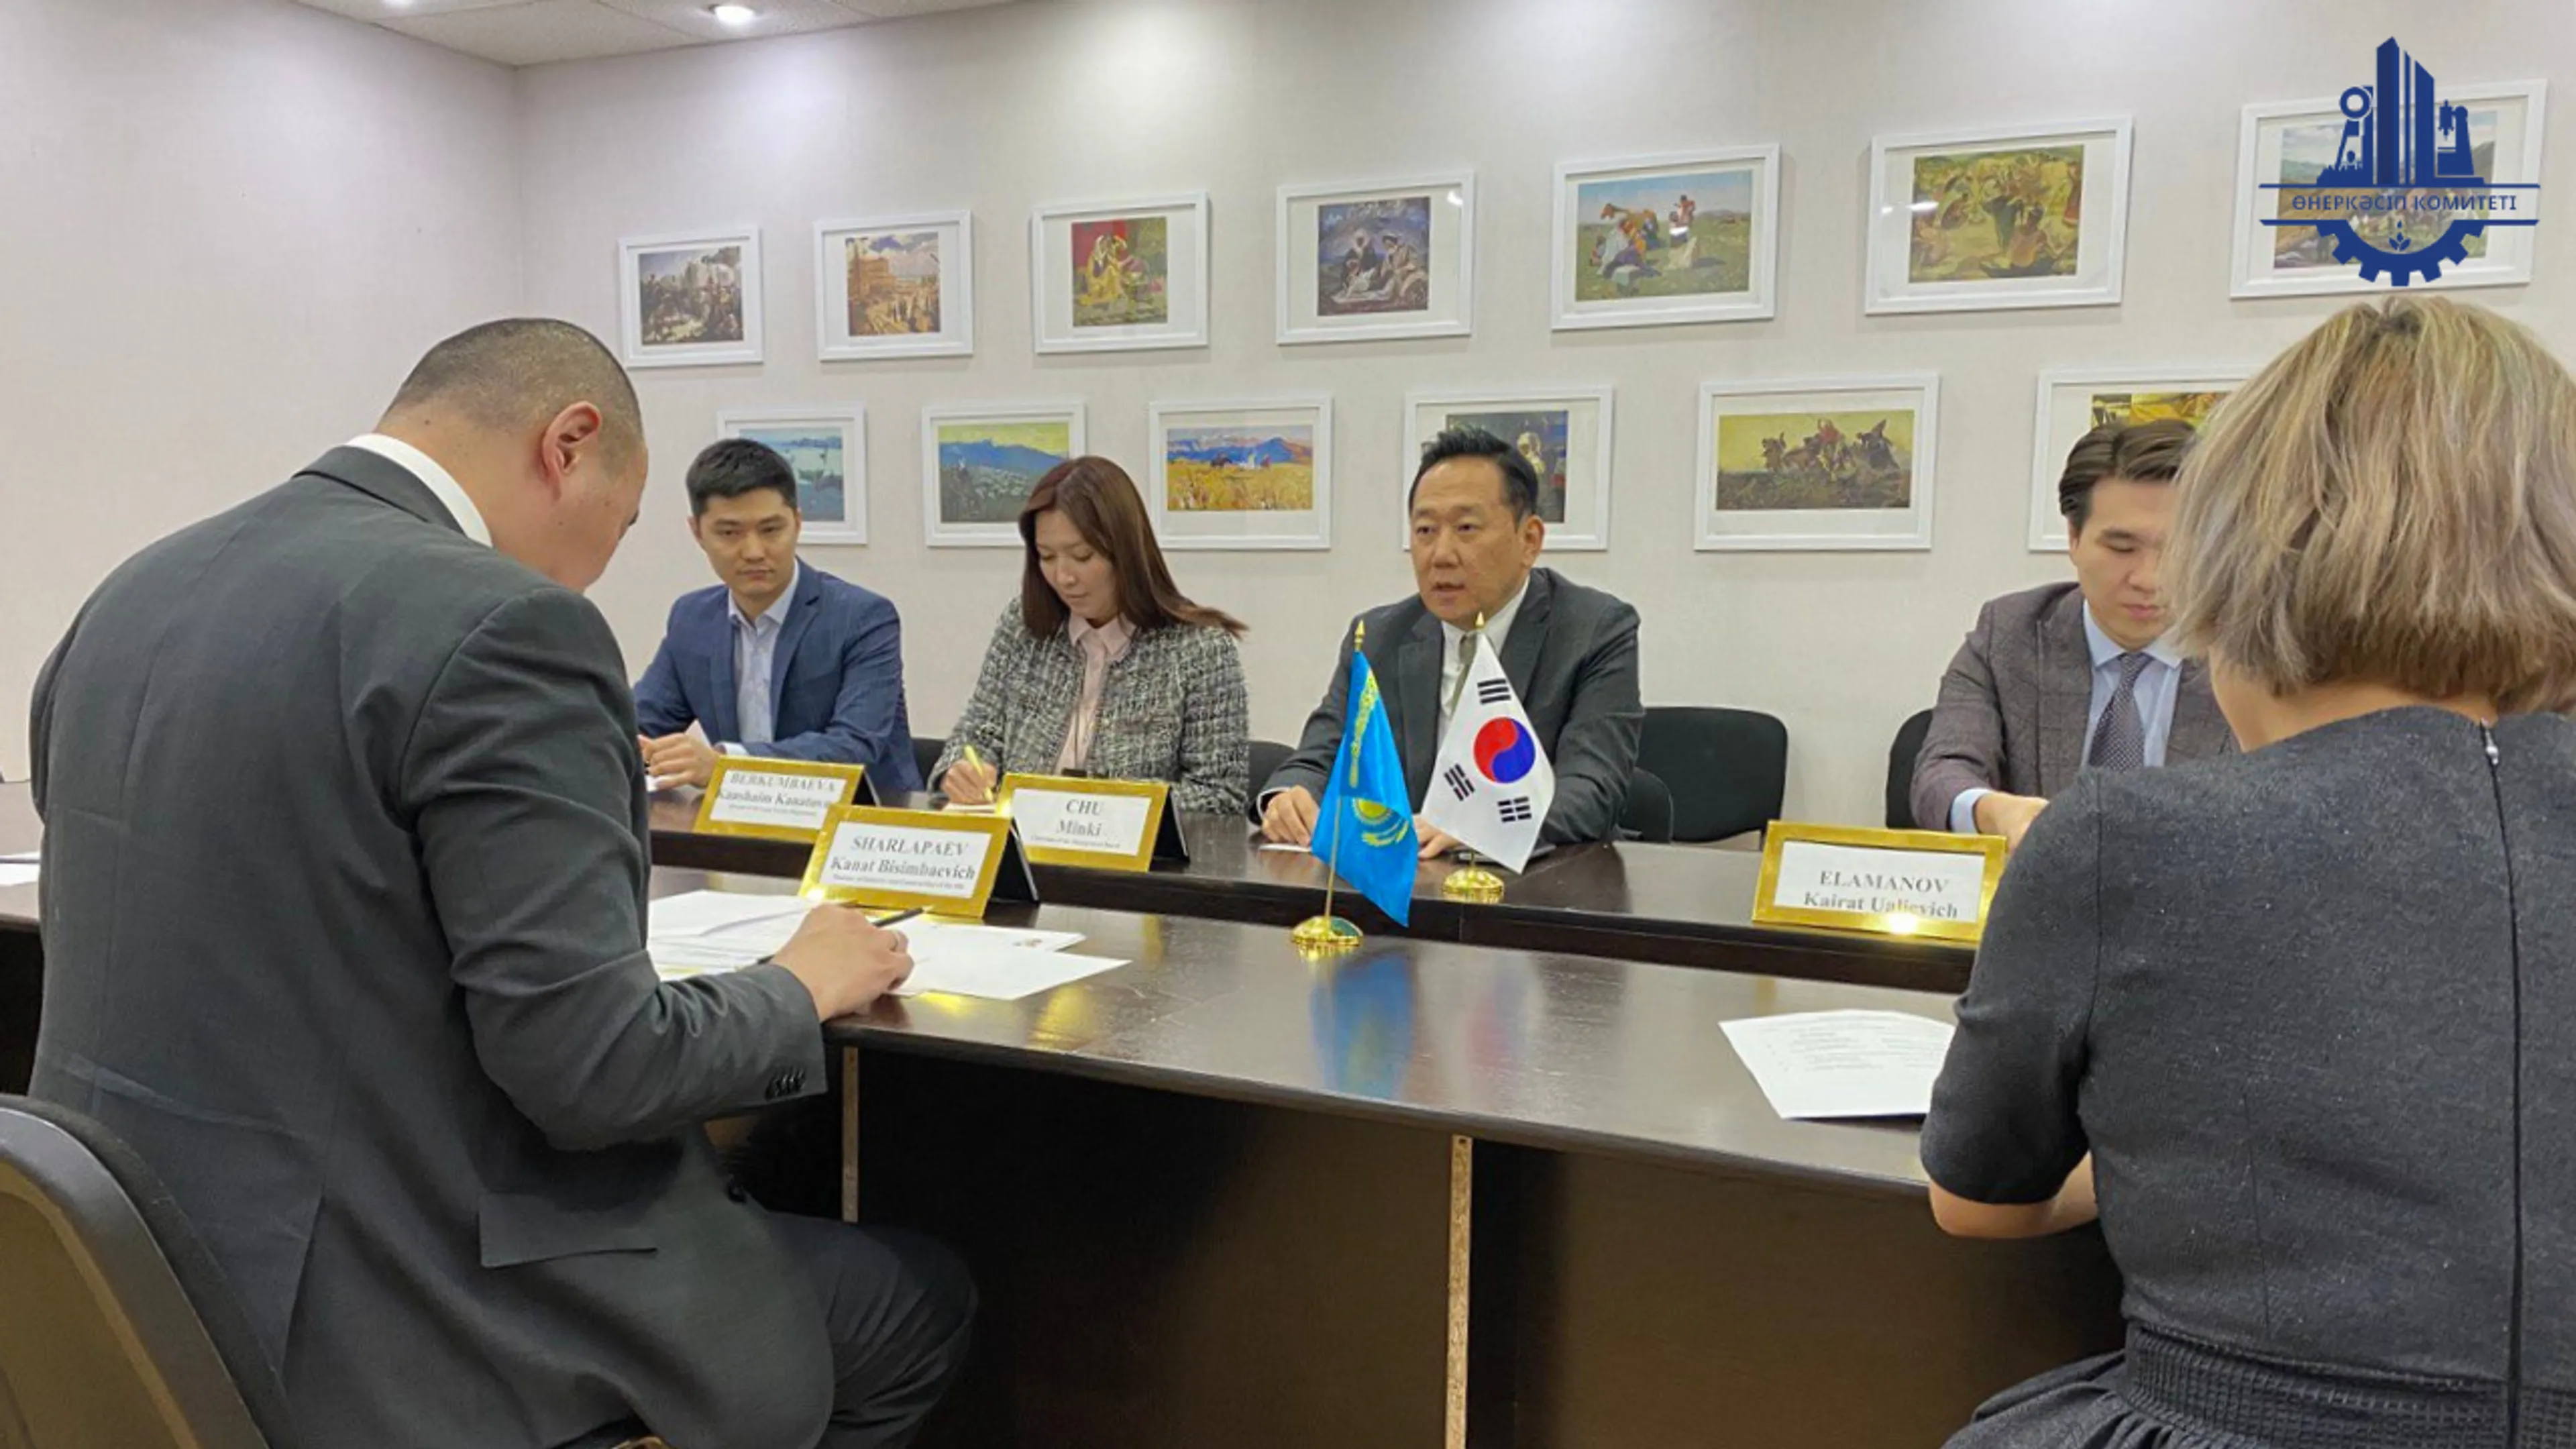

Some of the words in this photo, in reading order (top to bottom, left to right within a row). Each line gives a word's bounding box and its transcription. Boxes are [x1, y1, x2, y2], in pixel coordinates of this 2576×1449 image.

[1066, 799, 1105, 816] CHU
[1056, 819, 1102, 837] Minki
[851, 836, 969, 857] SHARLAPAEV
[830, 855, 875, 872] Kanat
[1820, 870, 1950, 894] ELAMANOV
[1804, 891, 1864, 910] Kairat
